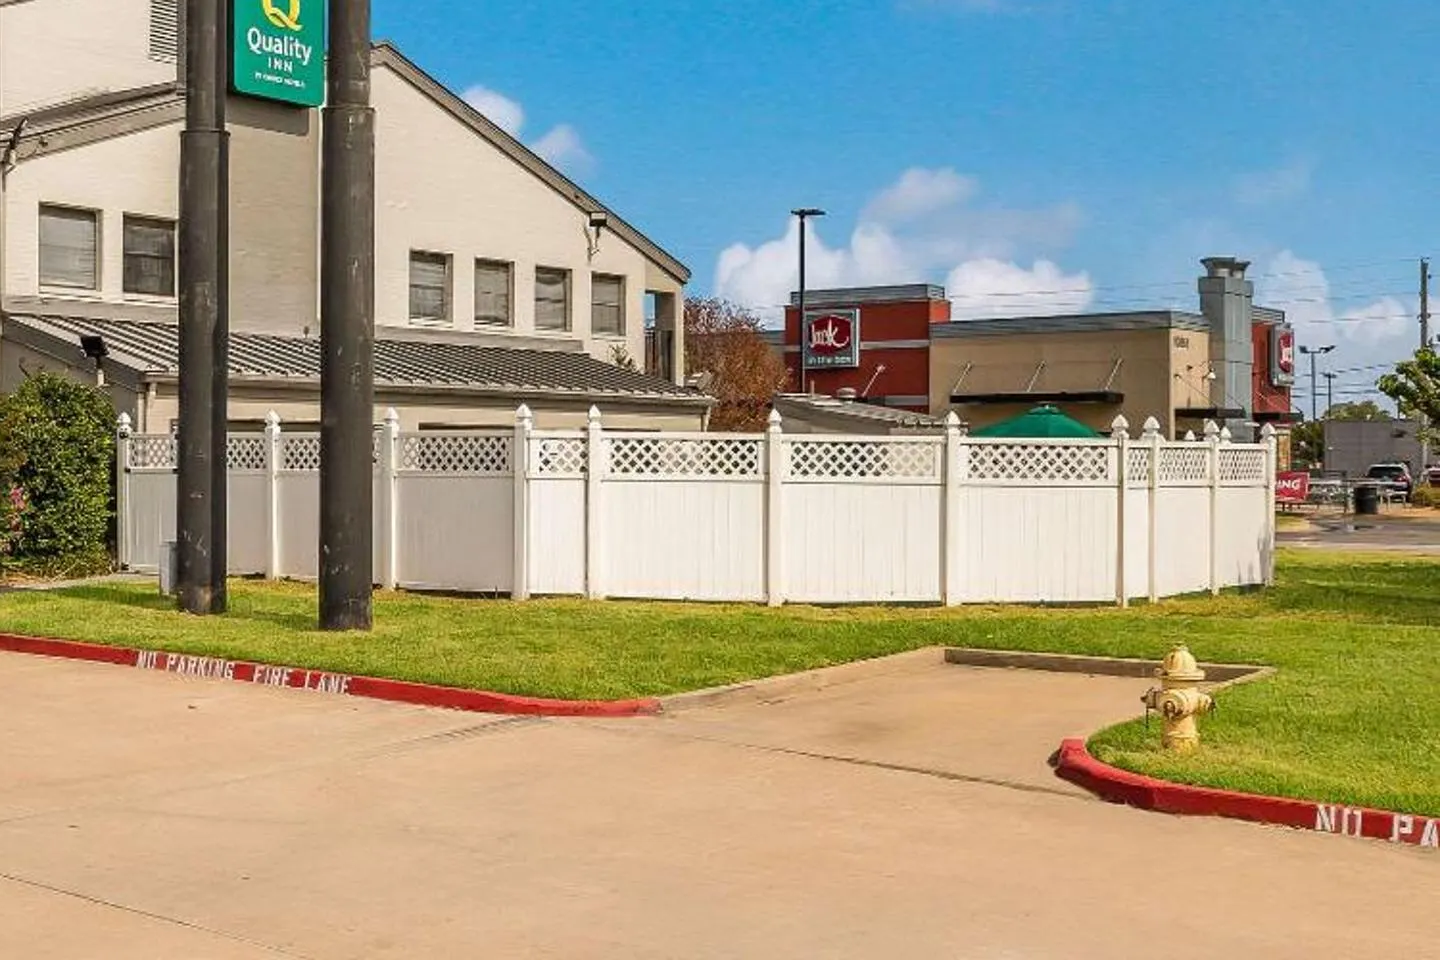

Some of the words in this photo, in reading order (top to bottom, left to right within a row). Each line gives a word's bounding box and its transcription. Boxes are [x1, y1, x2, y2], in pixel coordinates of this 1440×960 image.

[247, 26, 312, 66] Quality
[268, 56, 293, 74] INN
[165, 654, 235, 680] PARKING
[252, 665, 293, 688] FIRE
[303, 670, 354, 695] LANE
[1315, 803, 1363, 838] NO
